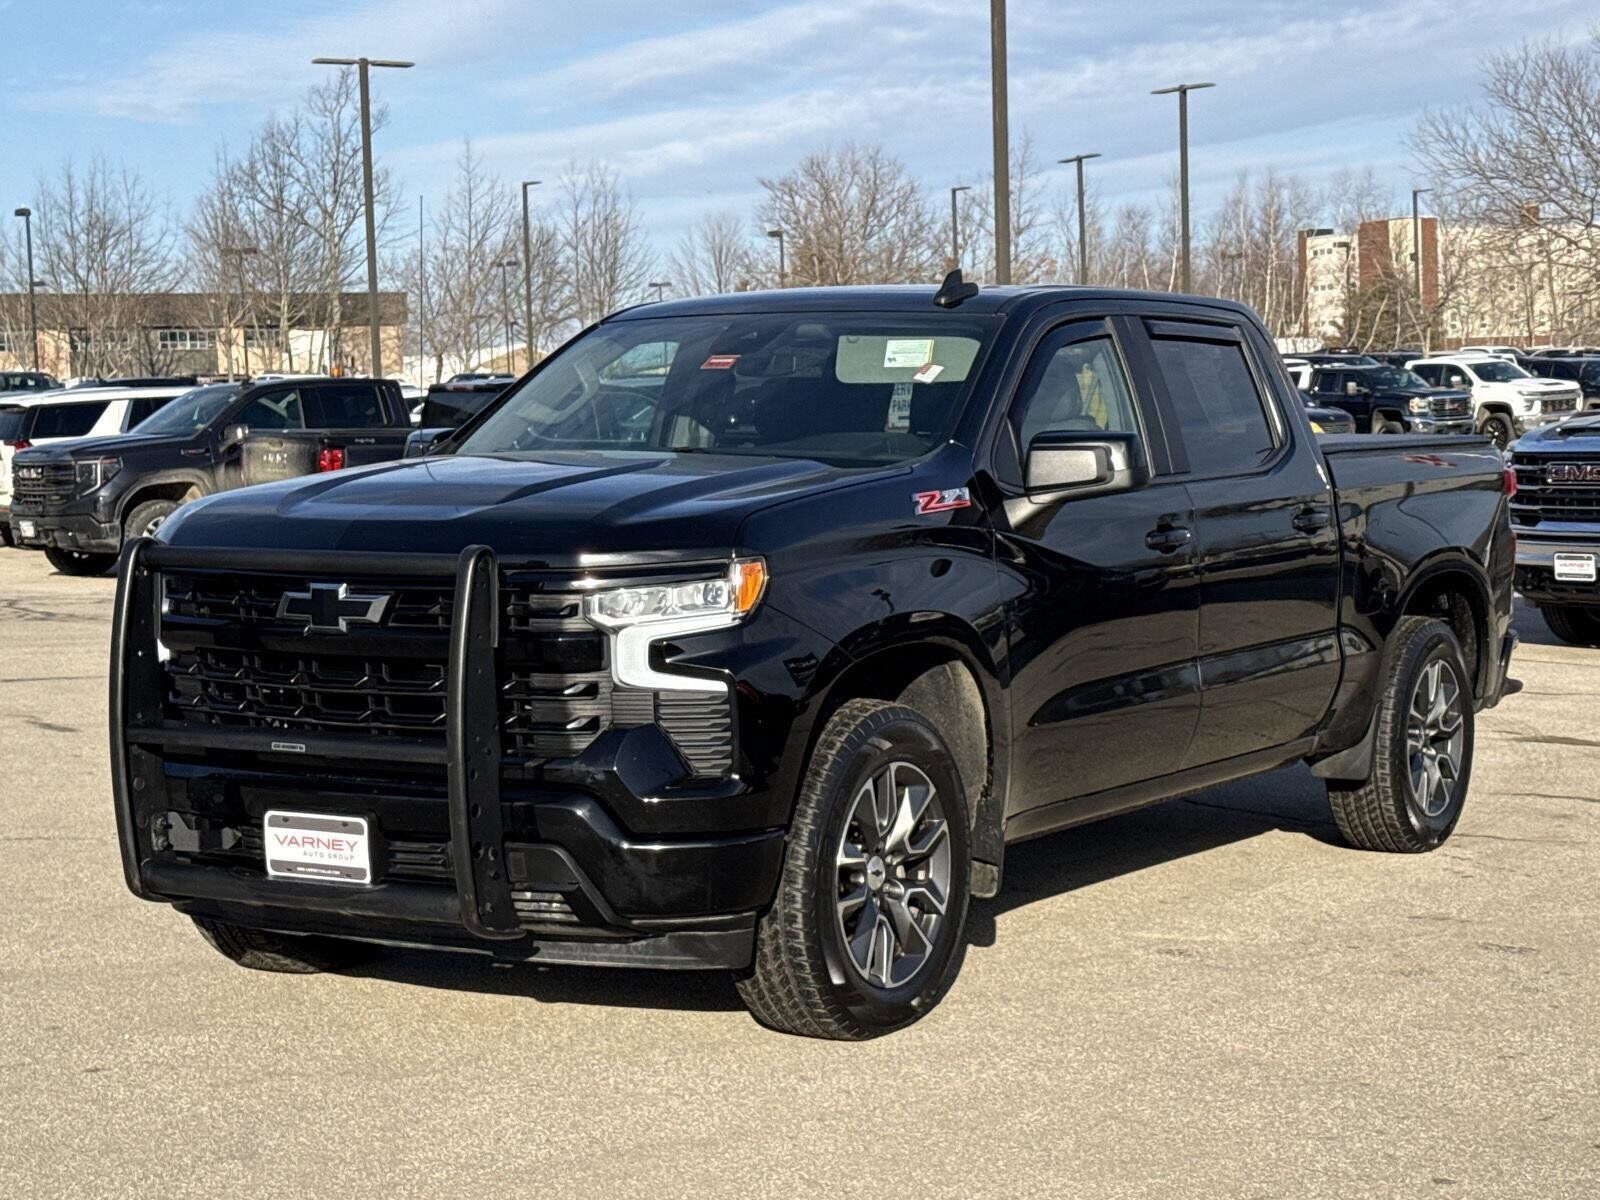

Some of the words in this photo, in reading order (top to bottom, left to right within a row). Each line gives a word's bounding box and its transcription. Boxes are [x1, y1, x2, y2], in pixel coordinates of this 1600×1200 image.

[274, 833, 358, 852] VARNEY
[303, 850, 325, 858] AUTO
[327, 853, 355, 861] GROUP
